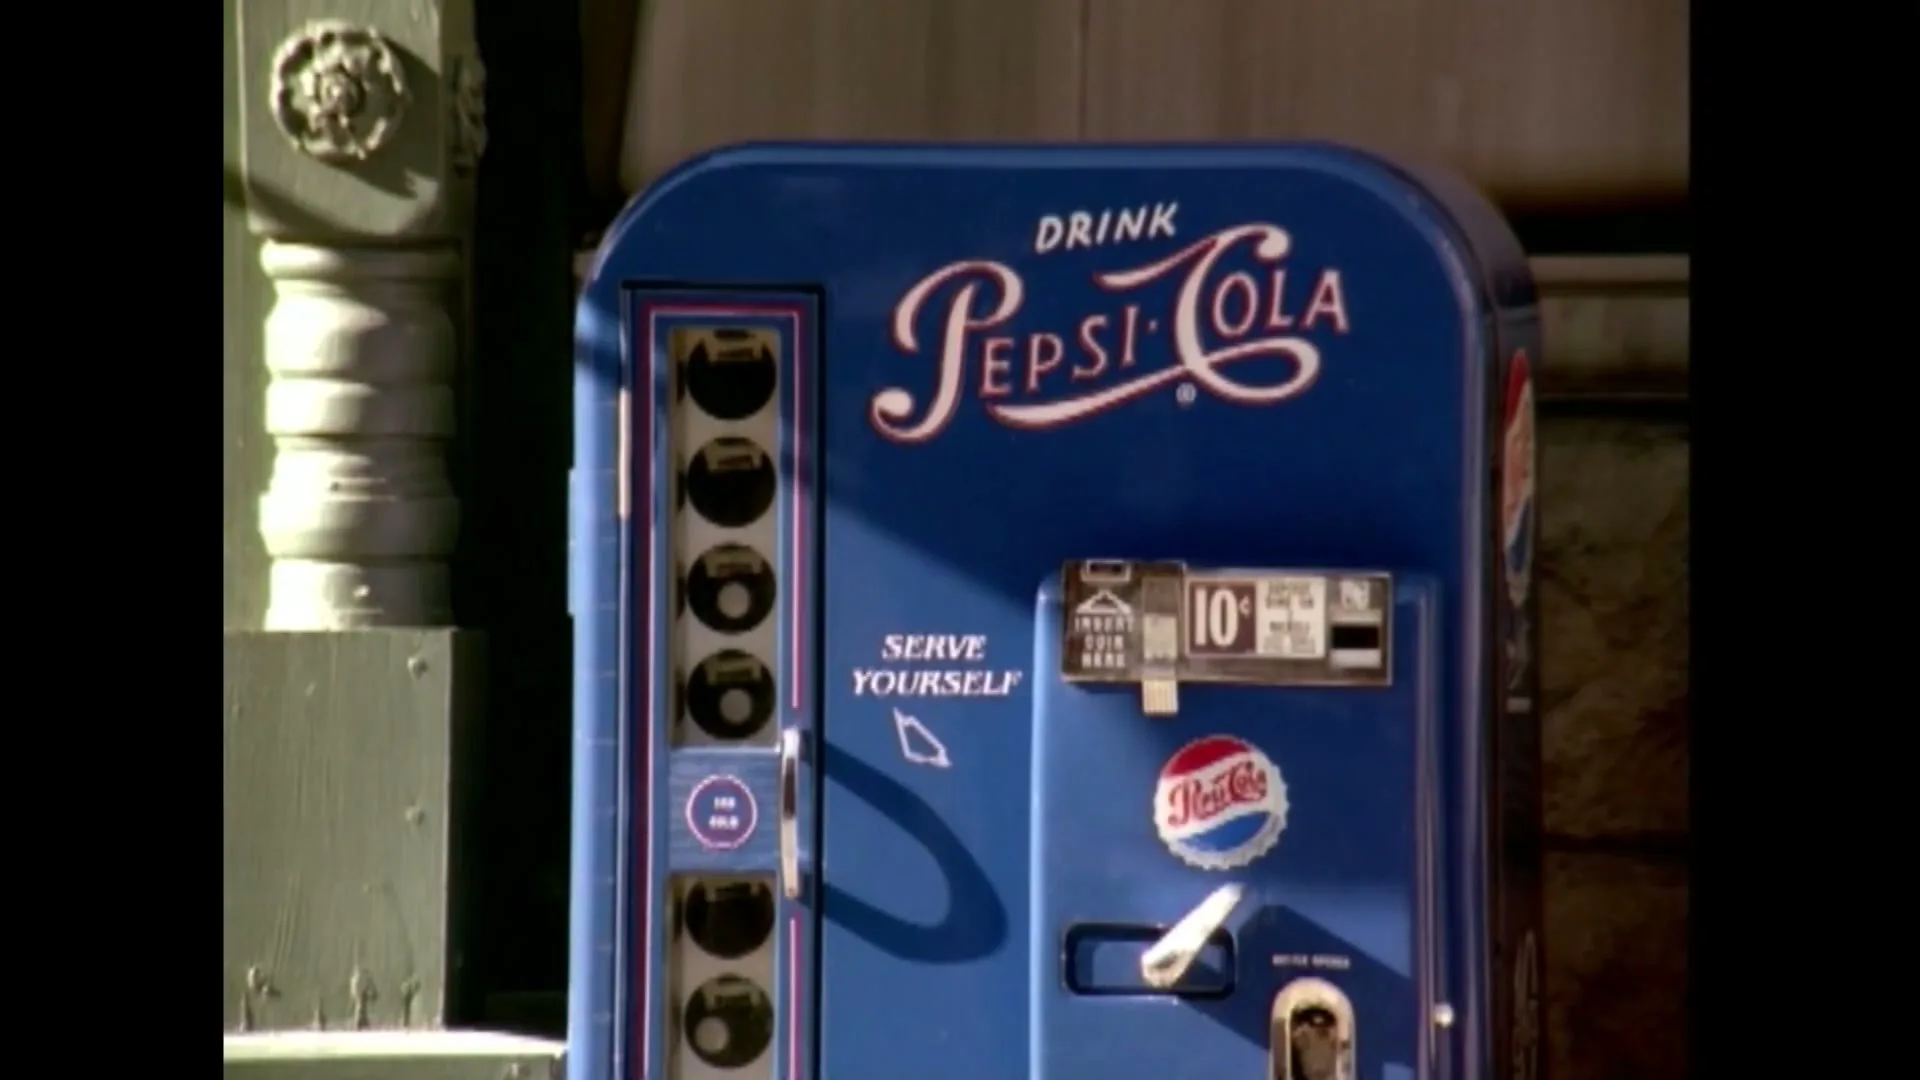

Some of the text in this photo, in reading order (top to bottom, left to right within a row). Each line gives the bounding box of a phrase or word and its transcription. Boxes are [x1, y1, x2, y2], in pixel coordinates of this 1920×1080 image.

[1034, 202, 1179, 254] DRINK
[881, 633, 987, 660] SERVE
[853, 669, 1023, 697] YOURSELF
